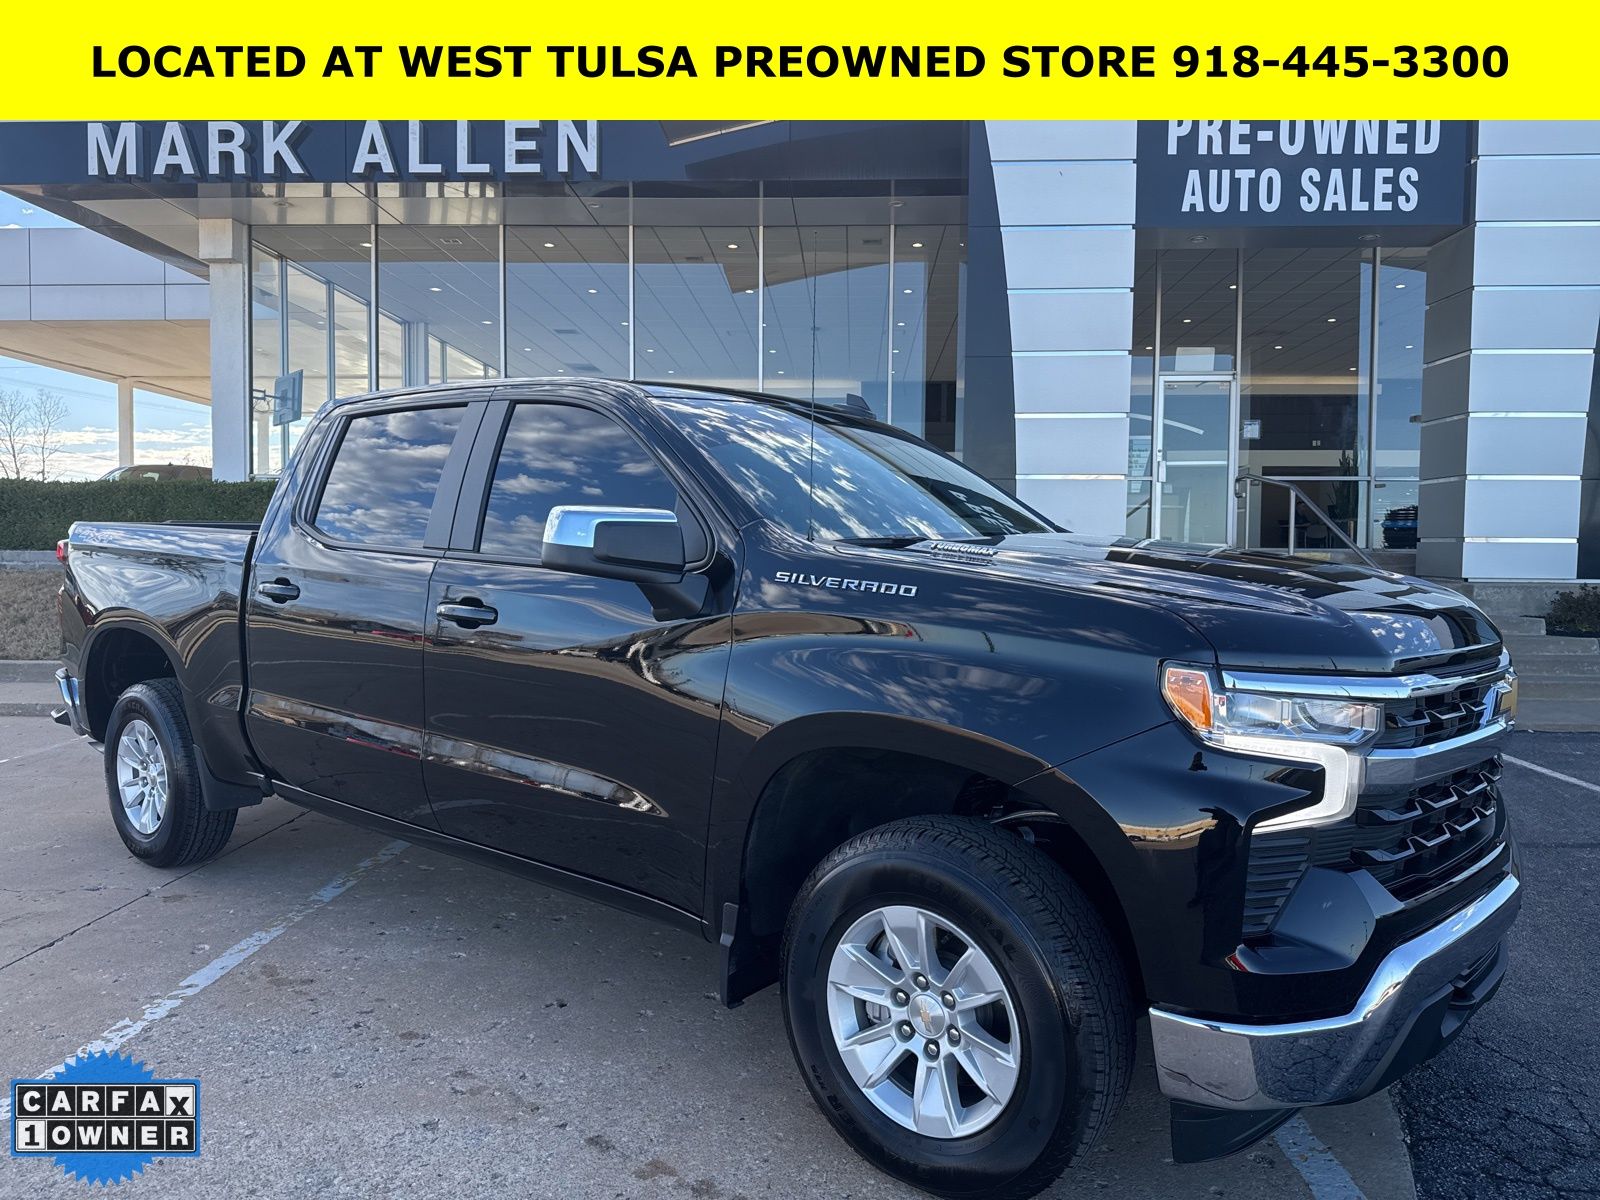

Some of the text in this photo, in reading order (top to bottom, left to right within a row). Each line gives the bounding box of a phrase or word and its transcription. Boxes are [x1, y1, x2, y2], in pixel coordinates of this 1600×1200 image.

[87, 120, 601, 176] MARK ALLEN
[1167, 120, 1442, 156] PRE-OWNED
[1181, 167, 1420, 213] AUTO SALES
[774, 571, 918, 597] SILVERADO
